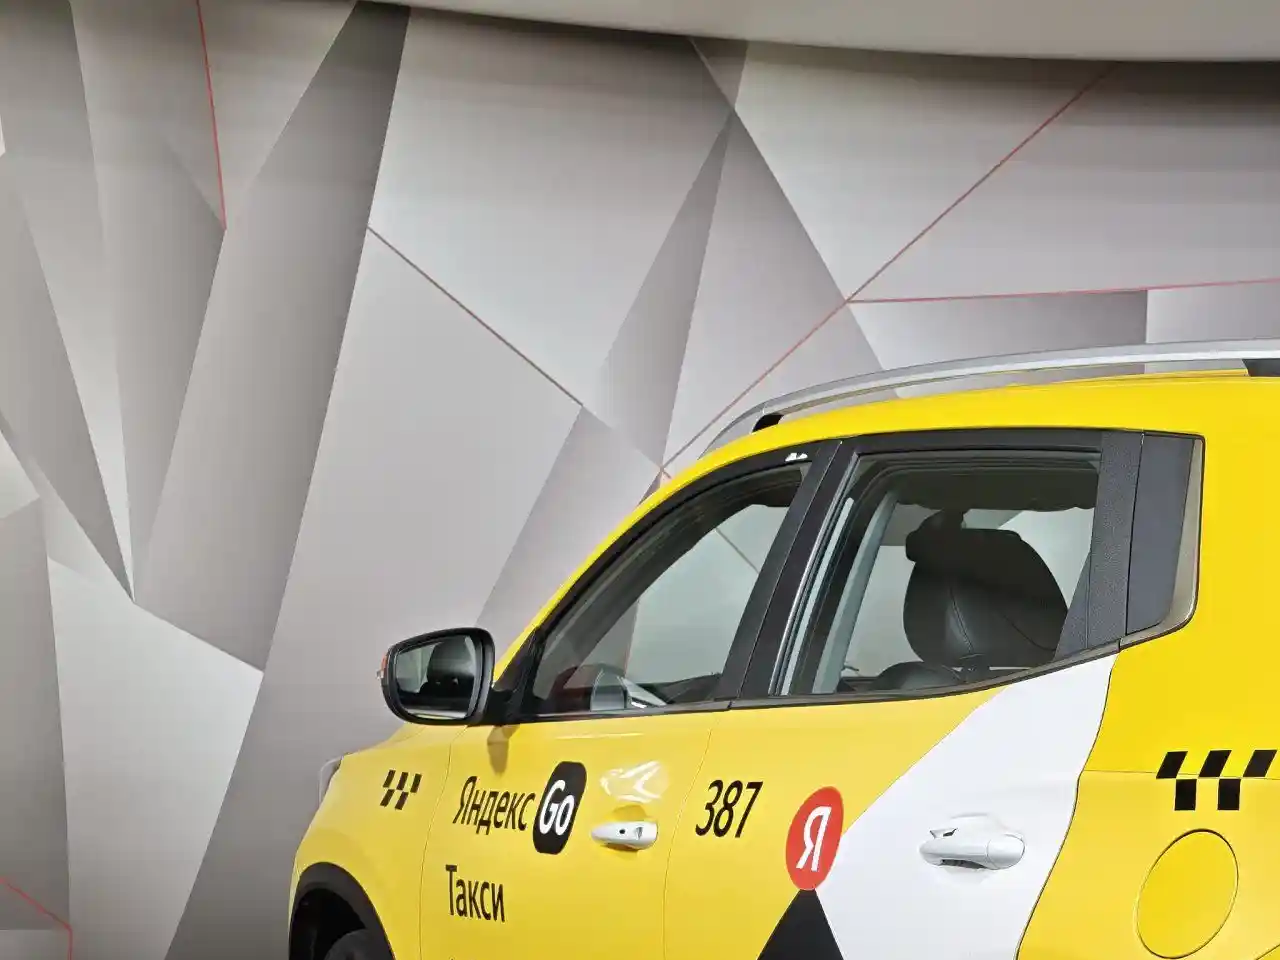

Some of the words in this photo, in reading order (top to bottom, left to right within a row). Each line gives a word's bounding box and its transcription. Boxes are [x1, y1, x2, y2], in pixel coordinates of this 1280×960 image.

[452, 775, 536, 836] Яндекс
[538, 779, 576, 836] Go
[695, 779, 764, 838] 387
[796, 805, 833, 872] Я
[445, 864, 506, 923] Такси
